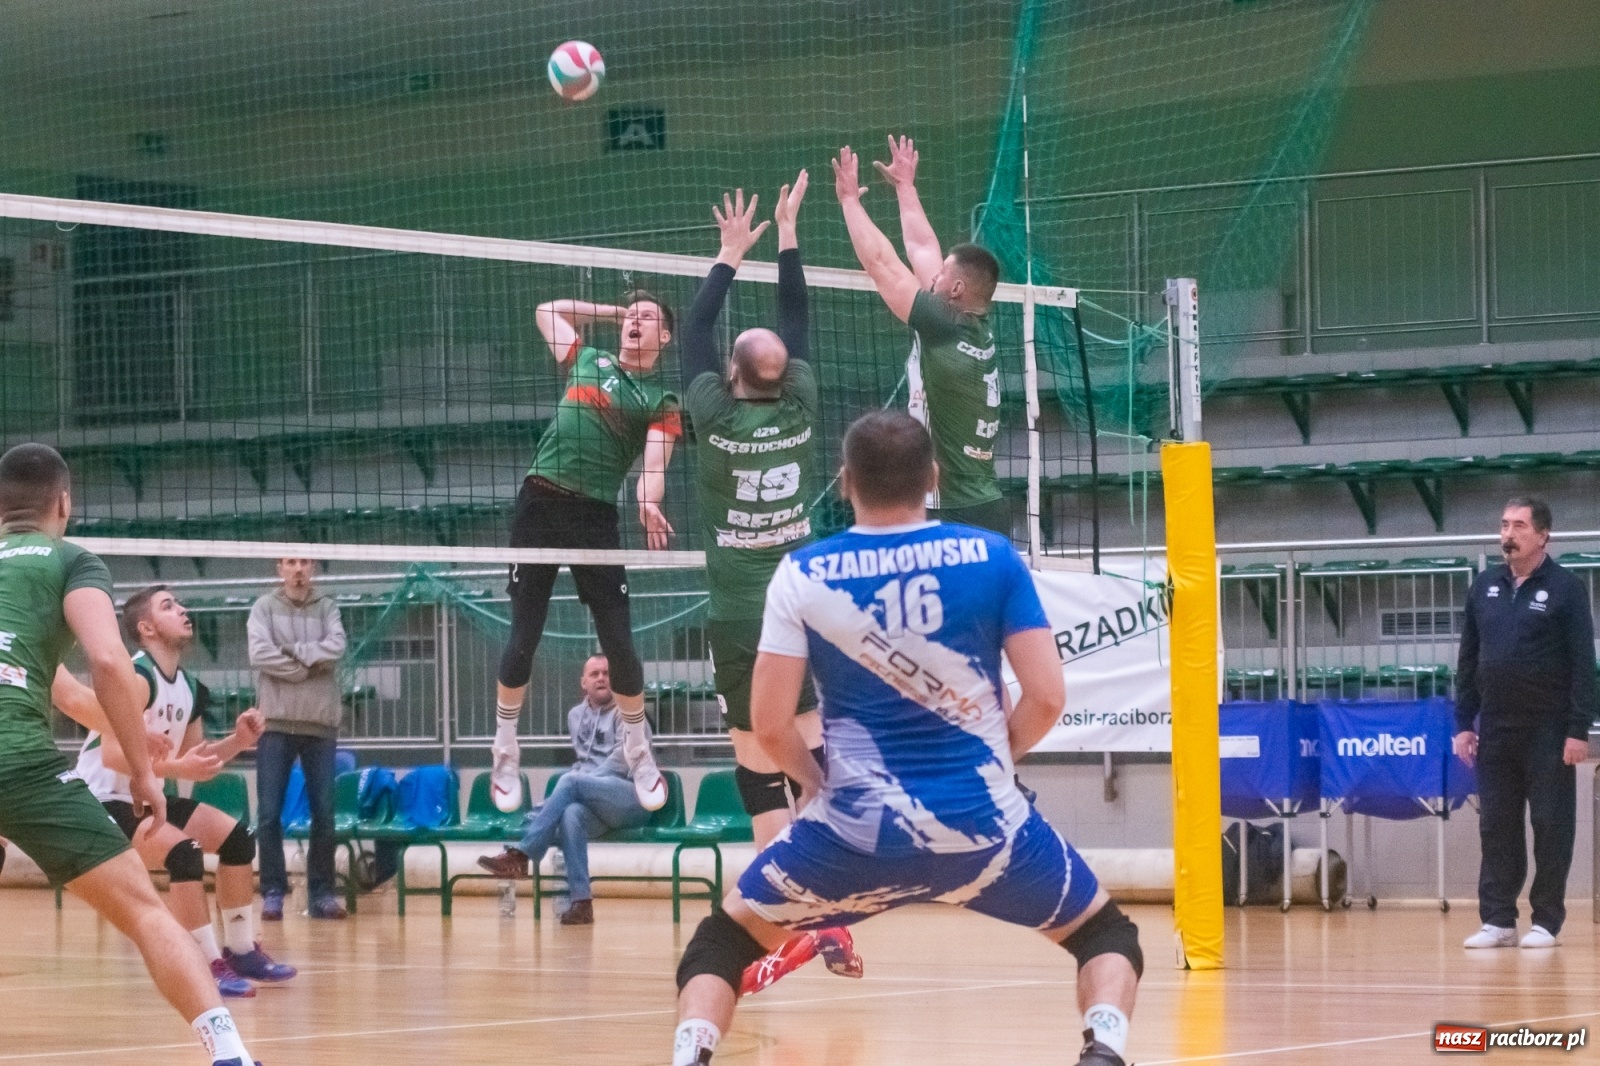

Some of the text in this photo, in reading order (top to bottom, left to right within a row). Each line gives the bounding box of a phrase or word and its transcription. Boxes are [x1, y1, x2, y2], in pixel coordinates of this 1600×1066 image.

[732, 462, 801, 502] 19
[808, 538, 989, 582] SZADKOWSKI
[875, 573, 943, 639] 16
[1338, 733, 1426, 757] molten
